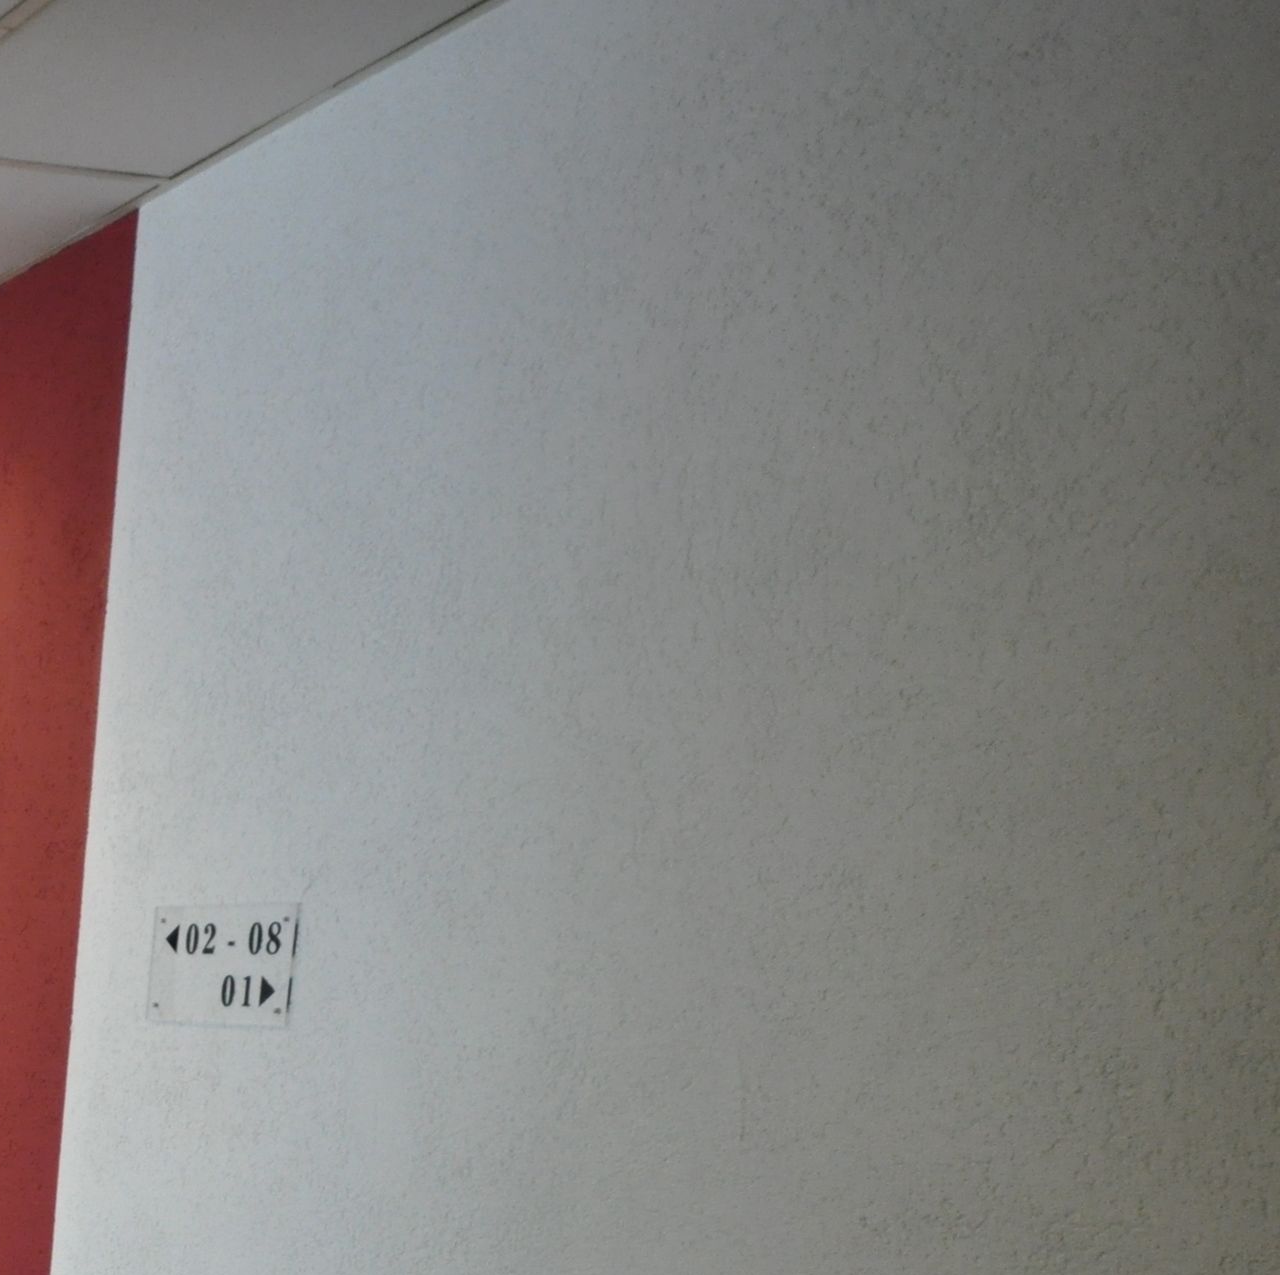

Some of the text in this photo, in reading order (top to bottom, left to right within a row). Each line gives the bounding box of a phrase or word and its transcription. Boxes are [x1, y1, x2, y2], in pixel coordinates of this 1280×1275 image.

[185, 923, 217, 955] 02
[248, 921, 283, 955] 08
[221, 974, 252, 1007] 01
